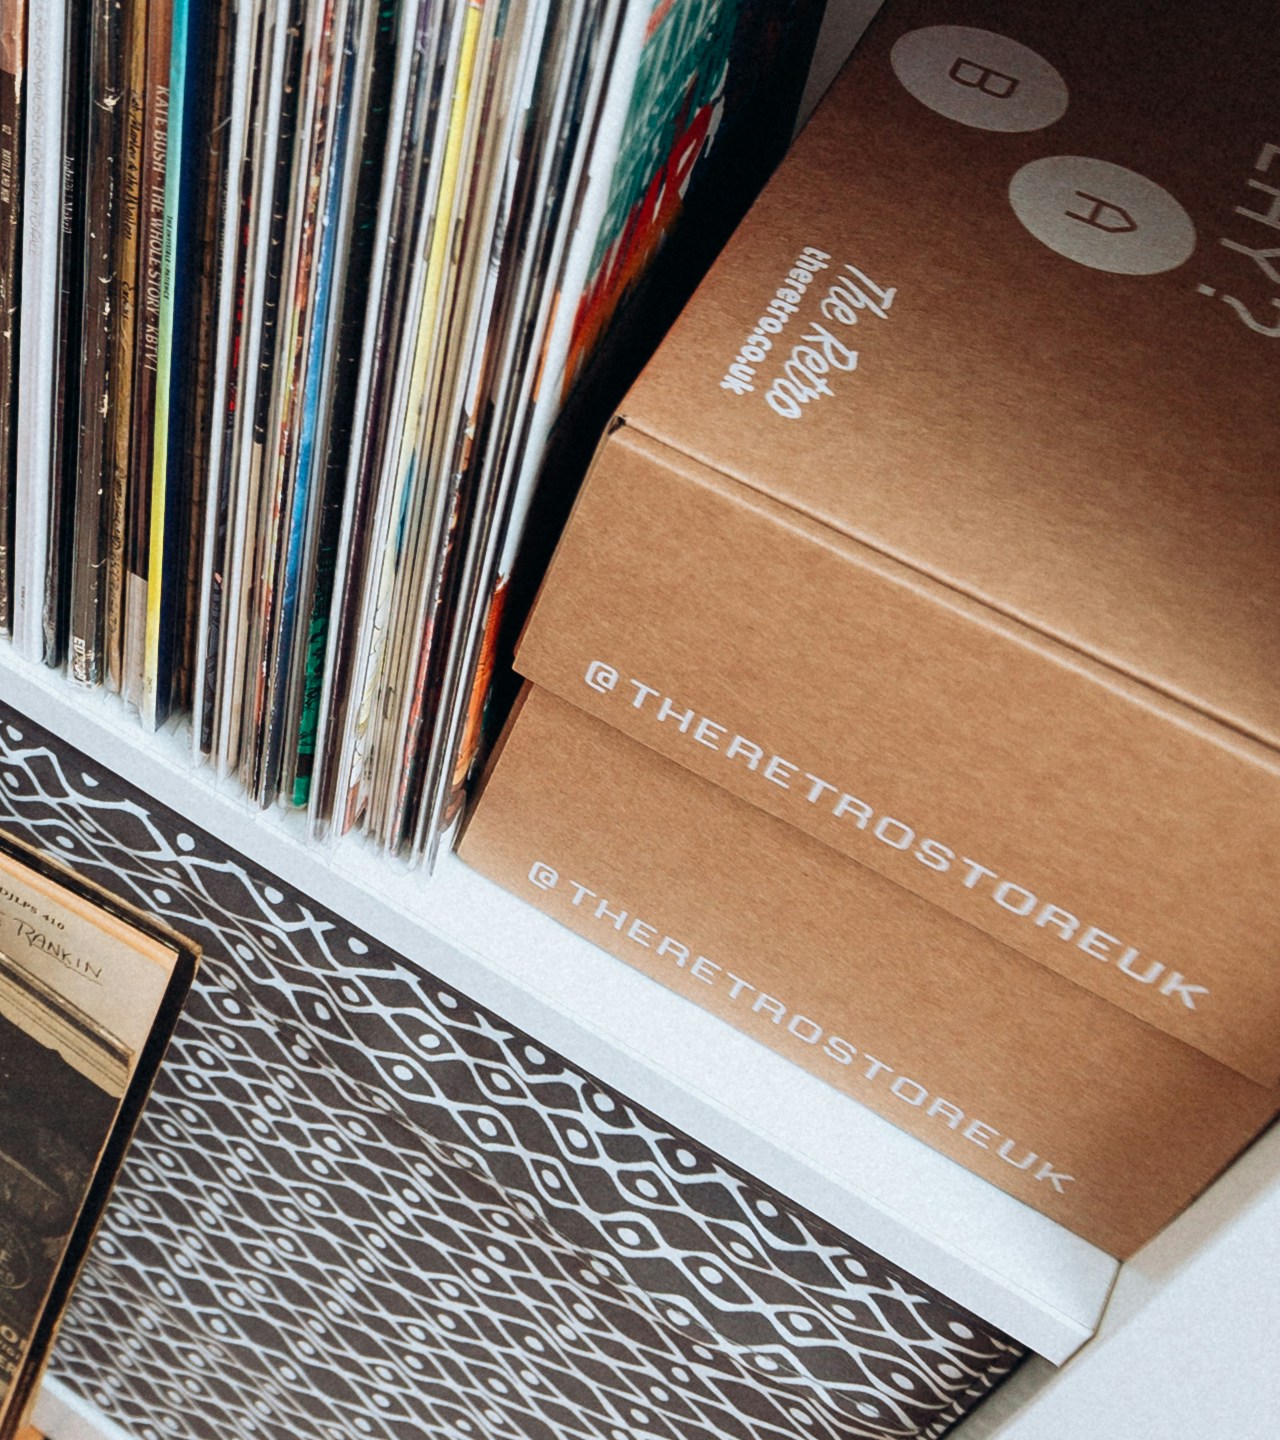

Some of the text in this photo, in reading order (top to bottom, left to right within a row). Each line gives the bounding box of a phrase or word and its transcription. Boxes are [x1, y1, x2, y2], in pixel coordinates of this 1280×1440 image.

[948, 56, 1020, 100] B
[144, 84, 170, 363] KATE BUSH THE WHOLE STORY KBTV
[164, 228, 173, 263] INVISIBLE
[1063, 190, 1138, 234] A
[719, 245, 832, 396] theretro.co.uk
[765, 263, 898, 420] The Retro
[583, 657, 1211, 1013] @THERETROSTOREUK
[13, 917, 103, 980] RANKIN
[42, 913, 66, 931] 410
[526, 859, 1078, 1196] @THERETROSTOREUK
